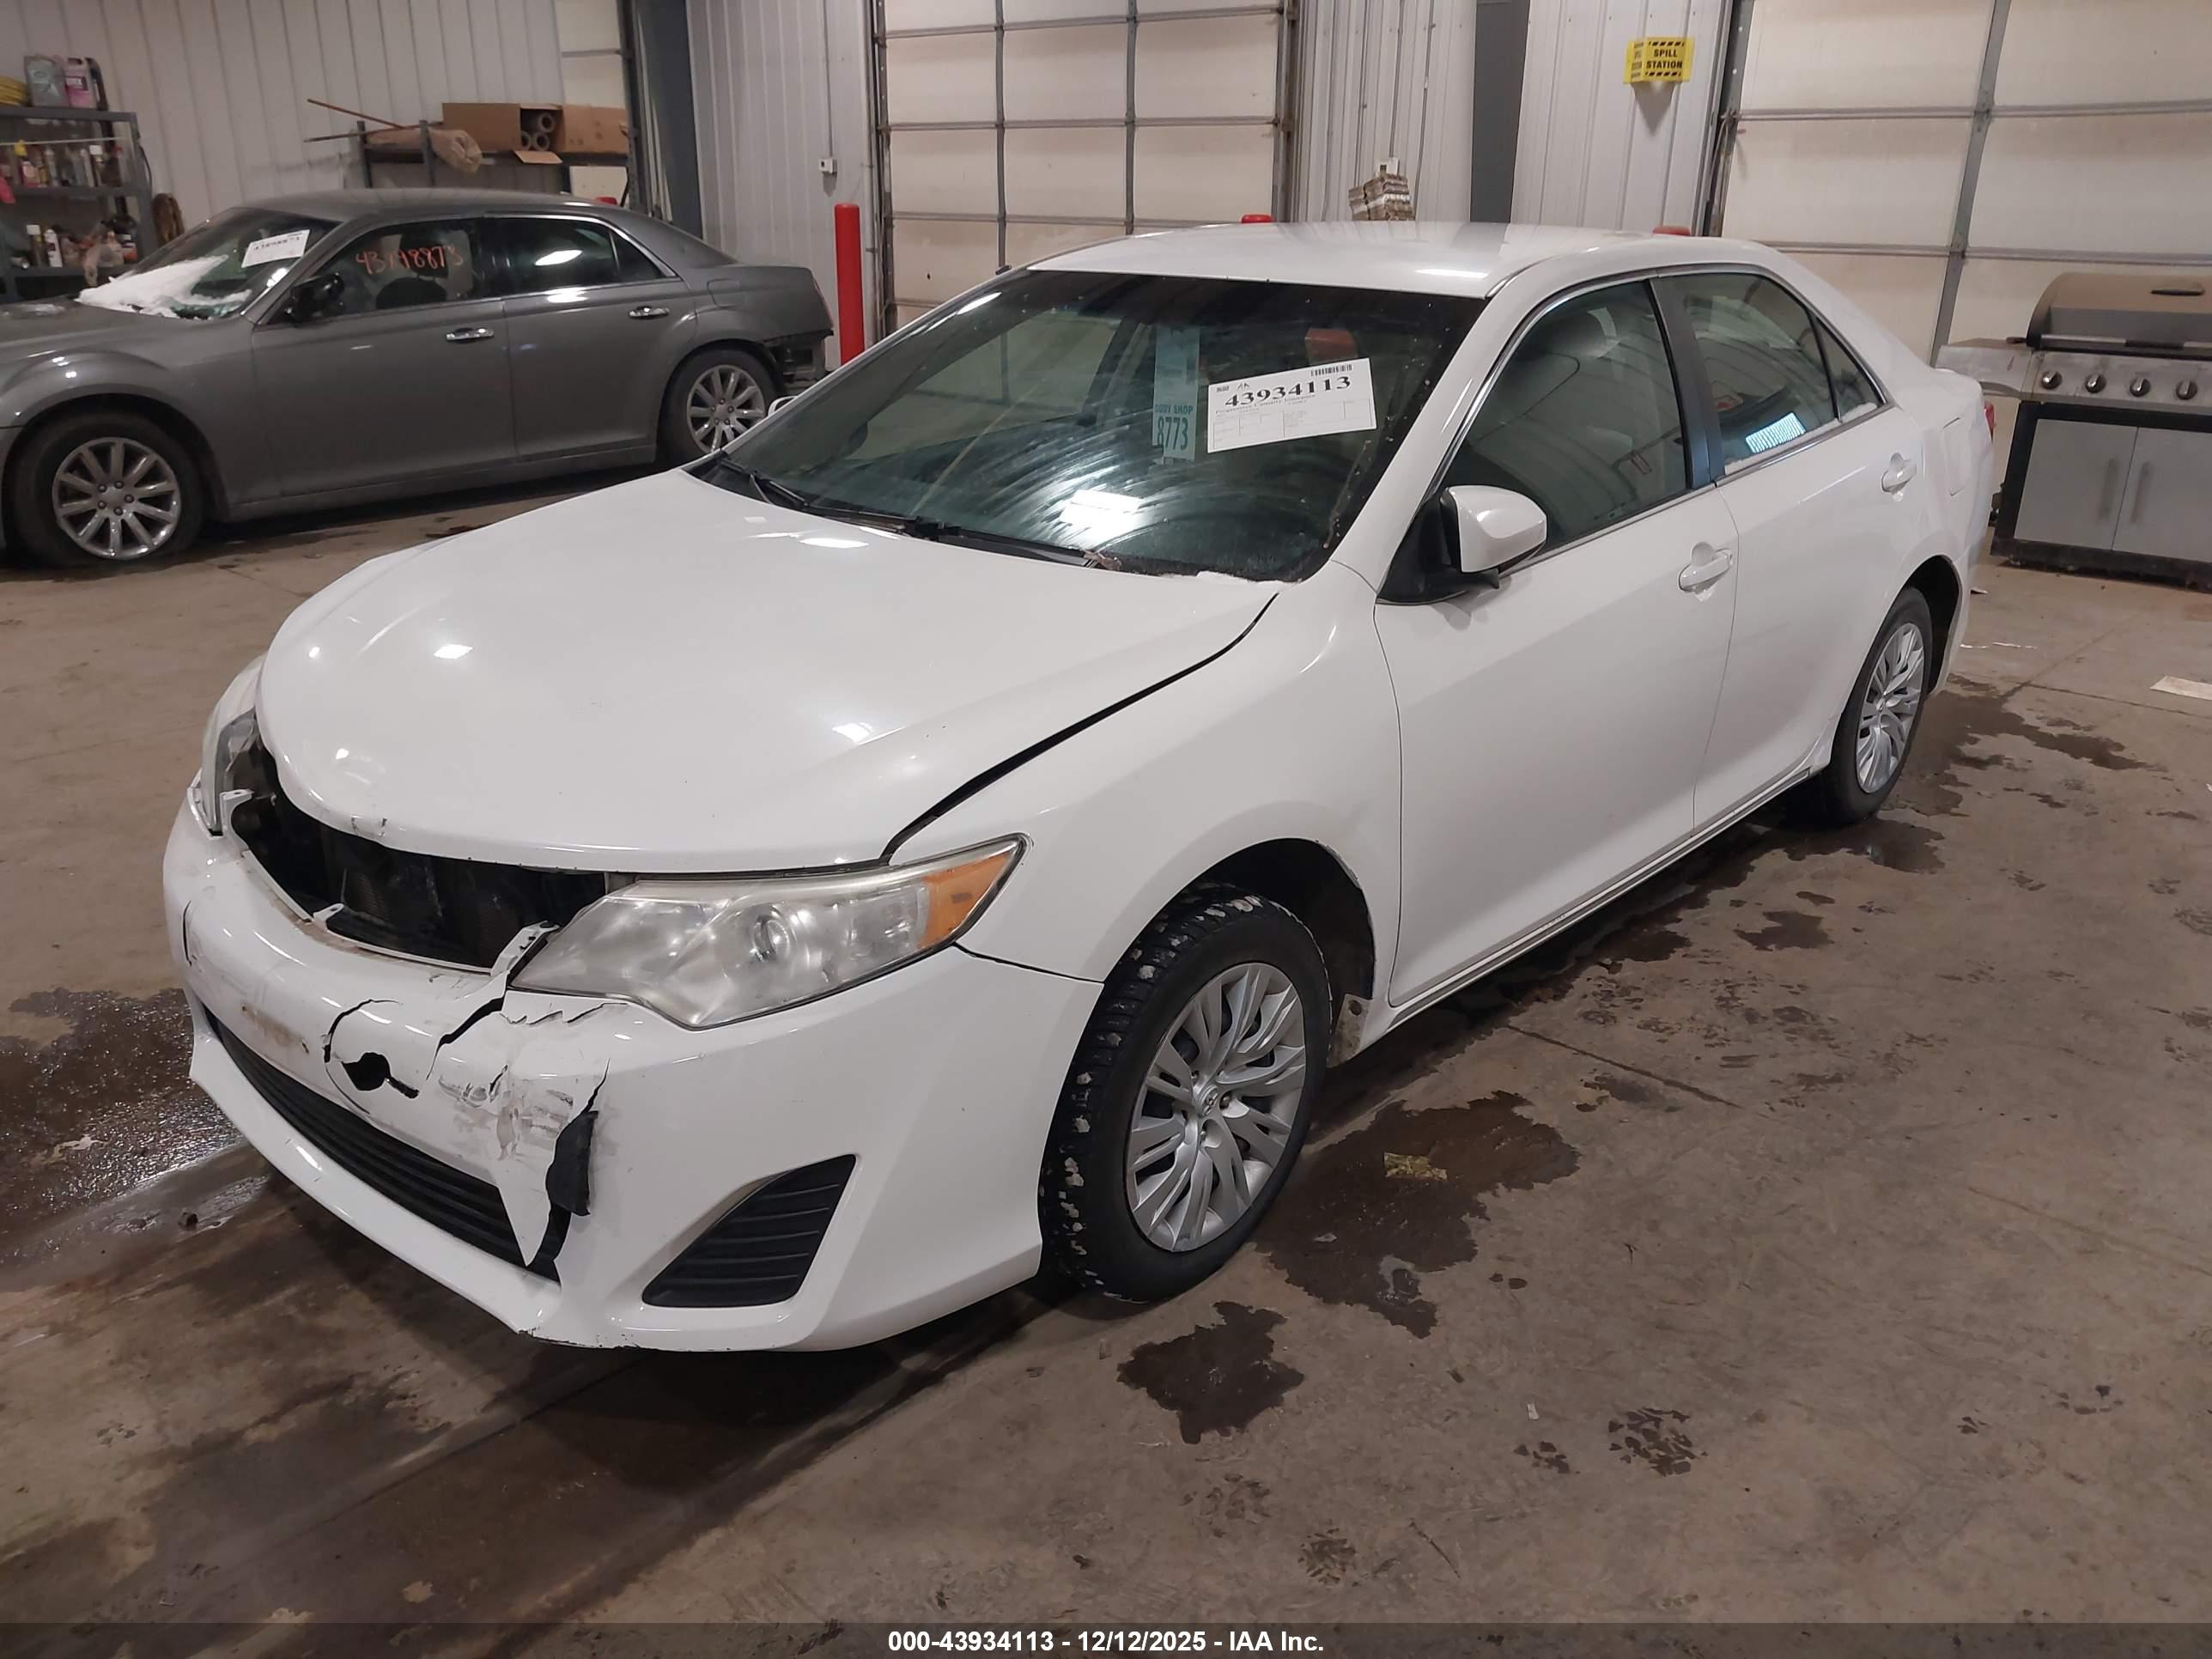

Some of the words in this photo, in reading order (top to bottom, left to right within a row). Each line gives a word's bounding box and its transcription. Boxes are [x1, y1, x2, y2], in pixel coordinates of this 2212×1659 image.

[1654, 49, 1678, 58] SPILL
[1646, 61, 1683, 70] STATION
[1224, 376, 1351, 406] 43934113
[1173, 405, 1194, 415] SHOP
[1158, 416, 1188, 450] 8773
